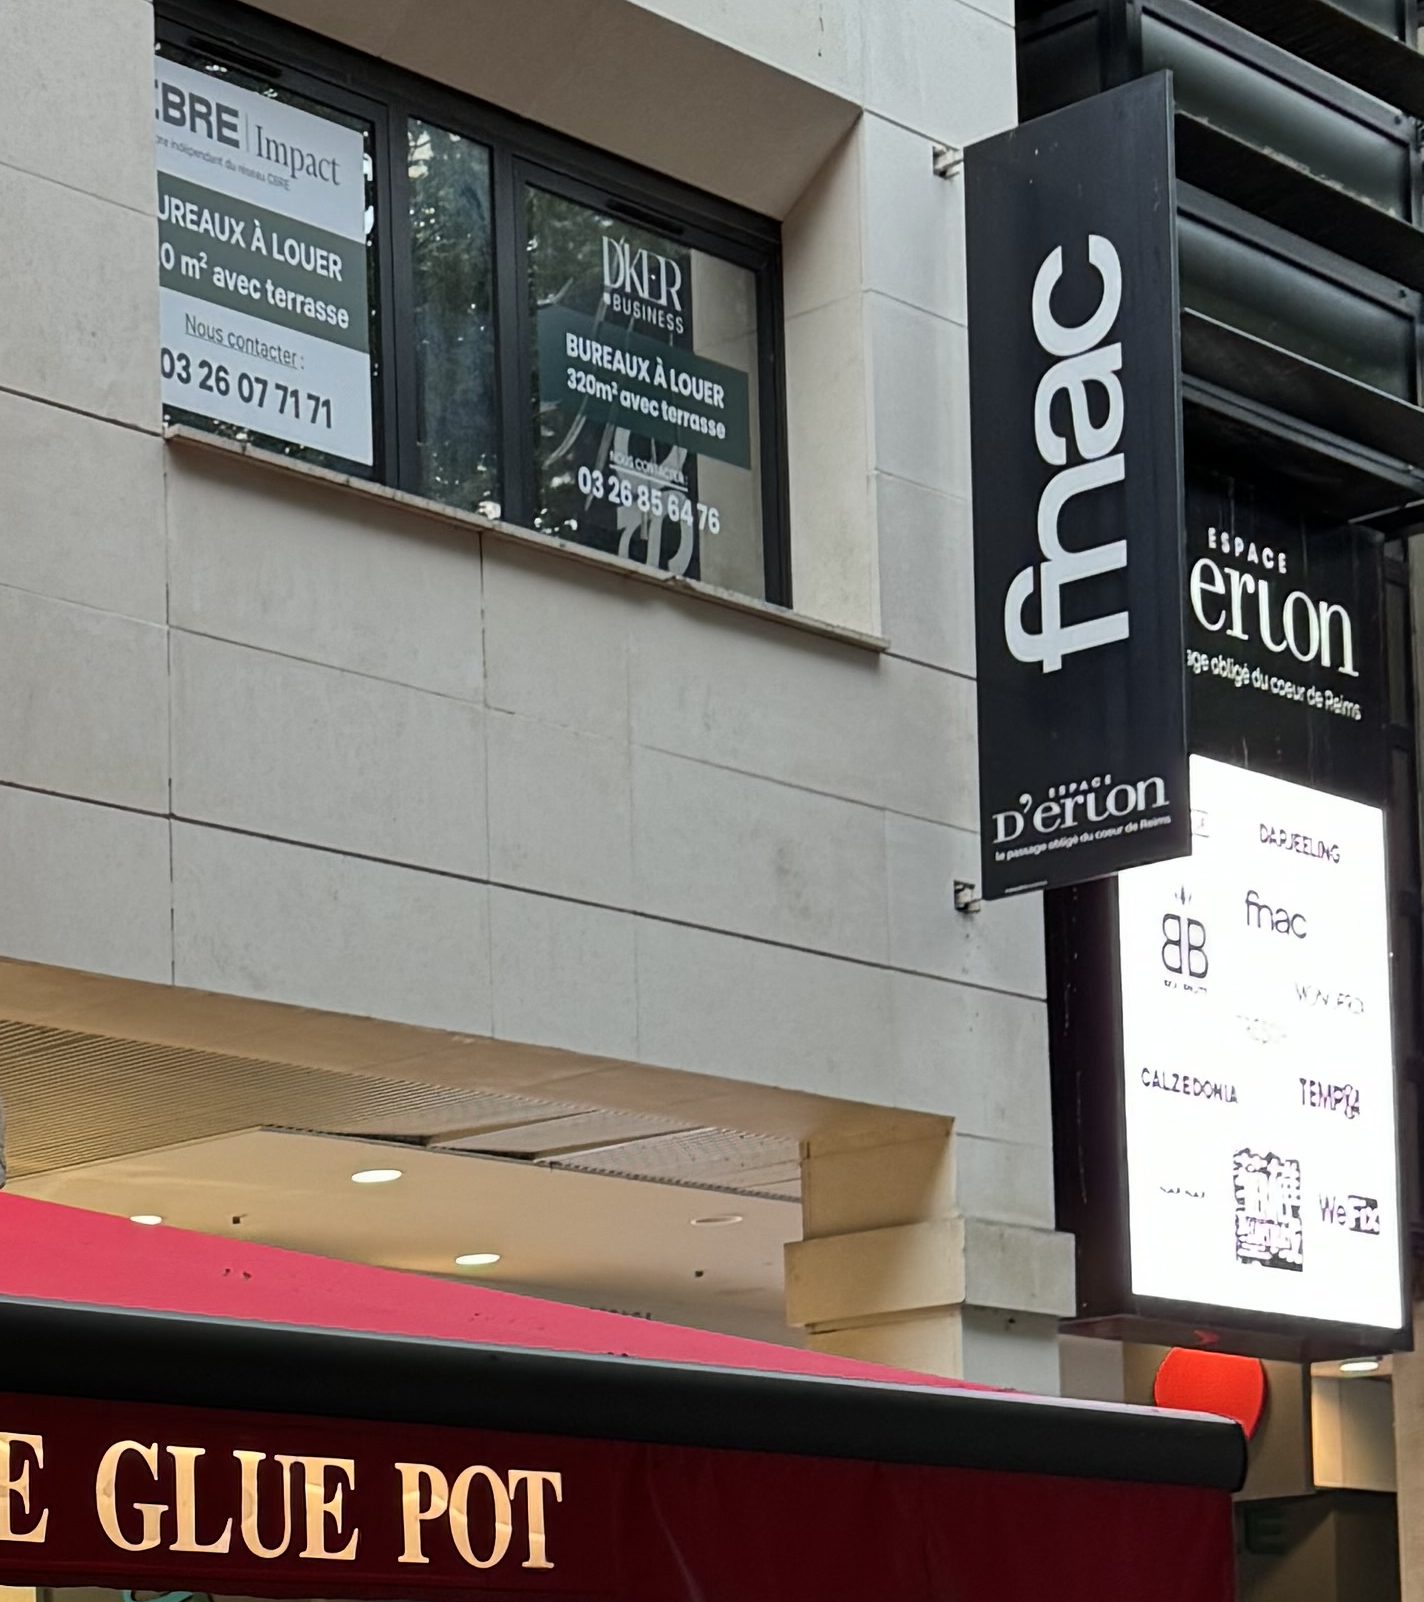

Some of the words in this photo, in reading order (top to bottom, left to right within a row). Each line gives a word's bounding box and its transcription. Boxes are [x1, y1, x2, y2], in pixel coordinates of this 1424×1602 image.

[154, 79, 241, 149] BRE
[256, 125, 342, 186] Impact
[251, 219, 268, 256] À
[272, 233, 343, 282] LOUER
[213, 266, 261, 300] avec
[265, 279, 349, 329] terrasse
[613, 293, 685, 334] BUSINESS
[185, 313, 224, 343] Nous
[227, 331, 299, 365] contacter
[566, 332, 651, 383] BUREAUX
[654, 357, 669, 389] À
[670, 369, 725, 408] LOUER
[161, 348, 192, 385] 03
[199, 360, 230, 396] 26
[238, 372, 269, 408] 07
[275, 383, 301, 419] 71
[306, 393, 332, 429] 71
[567, 368, 619, 402] 320m²
[620, 389, 660, 417] avec
[662, 400, 727, 440] terrasse
[1004, 234, 1130, 674] fnac
[578, 466, 604, 498] 03
[608, 476, 633, 507] 26
[637, 485, 663, 516] 85
[667, 494, 694, 526] 64
[697, 502, 720, 534] 76
[1208, 527, 1287, 574] ESPACE
[1252, 667, 1269, 690] du
[1307, 686, 1323, 708] de
[1048, 774, 1112, 798] ESPACE
[1245, 890, 1307, 939] fnac
[96, 1440, 359, 1561] GLUE
[395, 1462, 563, 1570] POT
